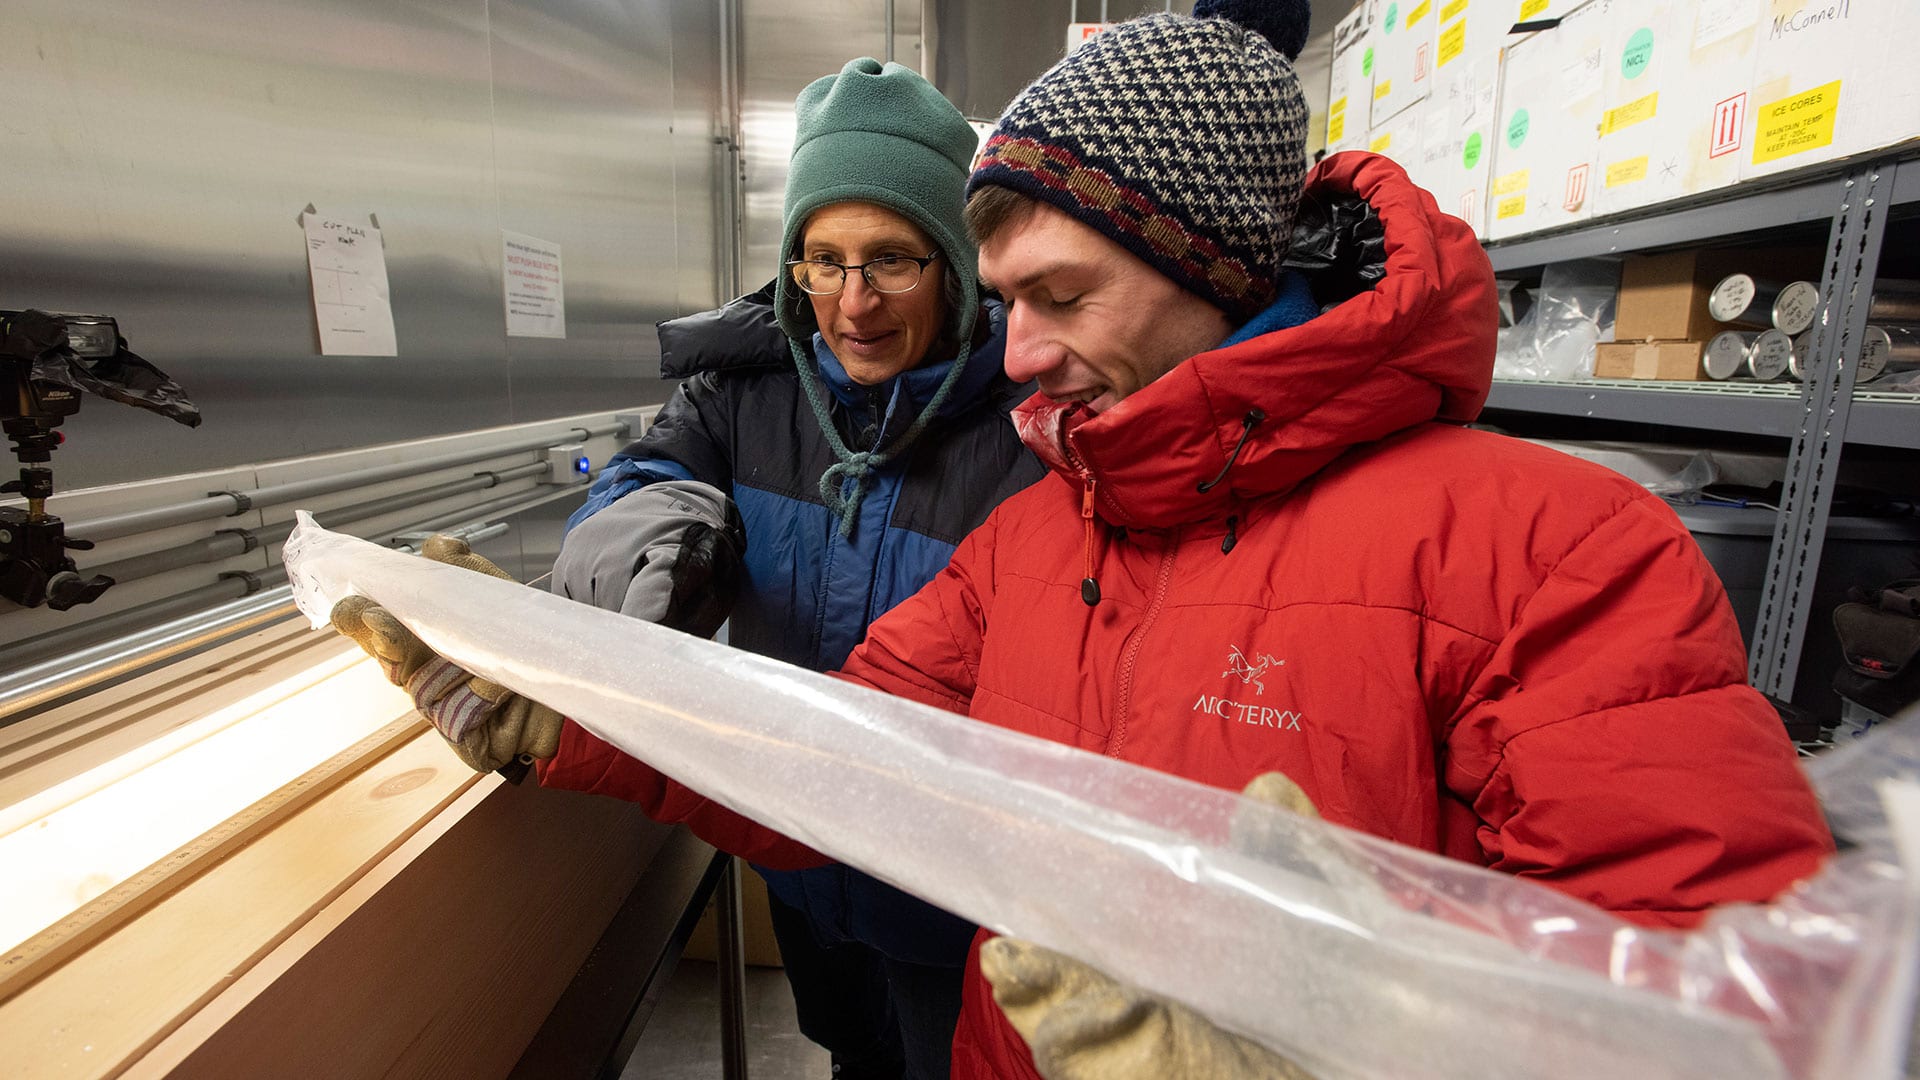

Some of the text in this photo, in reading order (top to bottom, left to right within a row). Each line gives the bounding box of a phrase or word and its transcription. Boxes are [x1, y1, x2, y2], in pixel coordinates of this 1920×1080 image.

[1769, 0, 1850, 40] McConnell
[1626, 52, 1646, 69] NICL
[1772, 93, 1823, 118] ICE CORES
[1766, 113, 1824, 137] MAINTAIN TEMP
[1766, 133, 1818, 153] KEEP FROZEN
[1778, 133, 1788, 142] AT
[1193, 693, 1302, 732] ARC'TERYX
